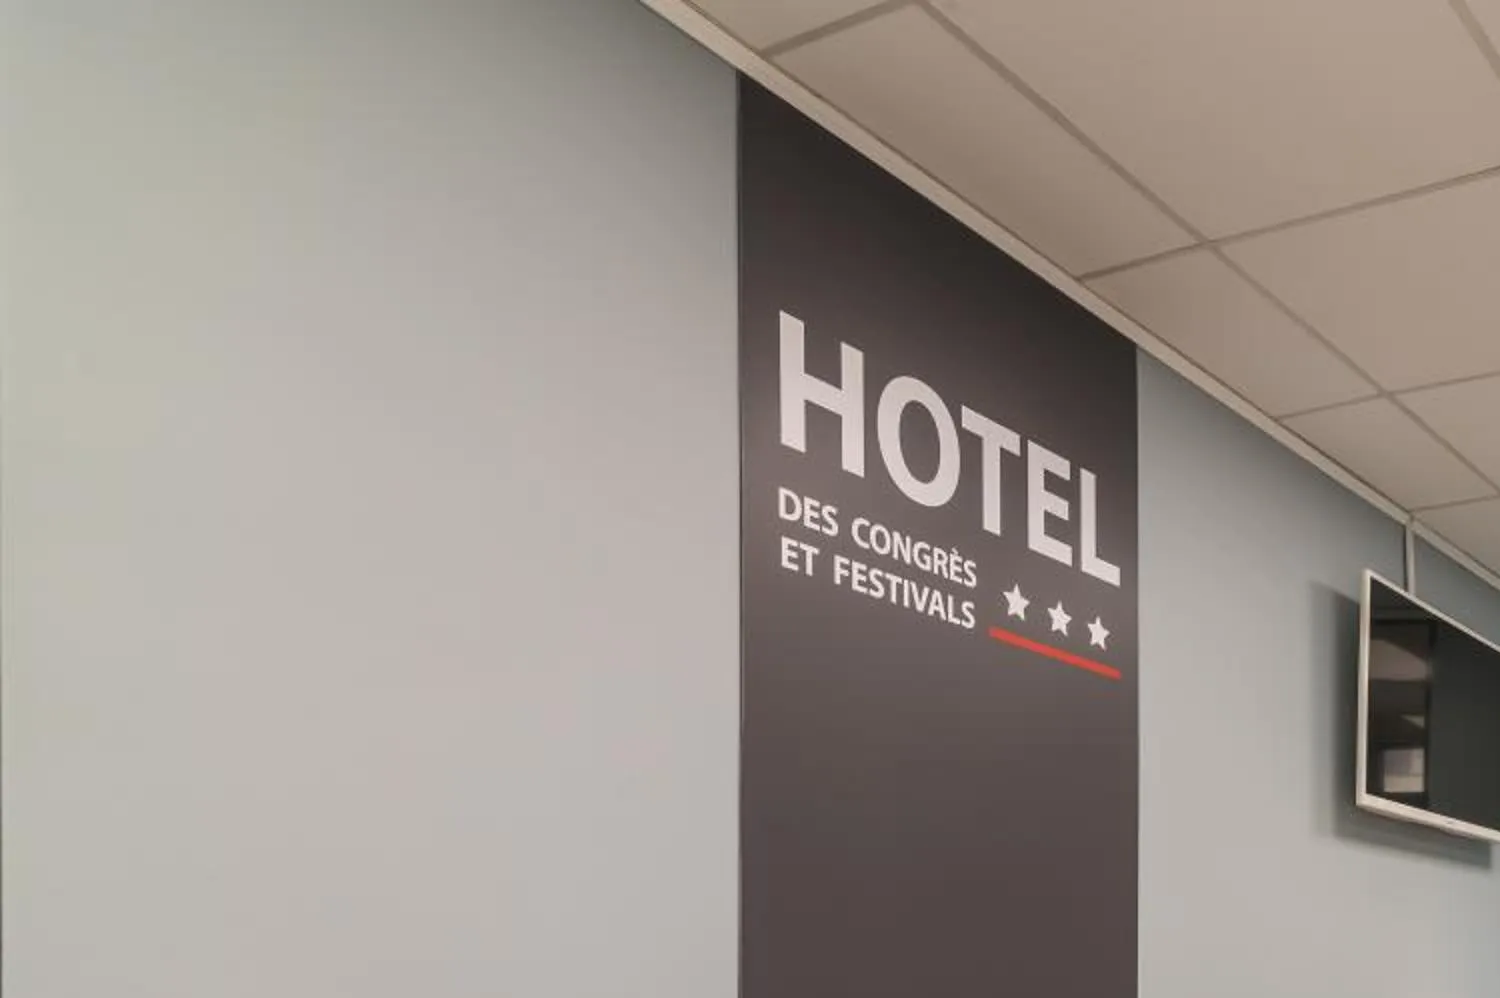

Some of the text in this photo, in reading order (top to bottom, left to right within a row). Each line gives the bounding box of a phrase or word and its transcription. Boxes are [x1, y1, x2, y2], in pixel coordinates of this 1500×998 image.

[779, 309, 1121, 588] HOTEL
[778, 486, 977, 589] DES CONGRÈS
[780, 535, 976, 629] ET FESTIVALS
